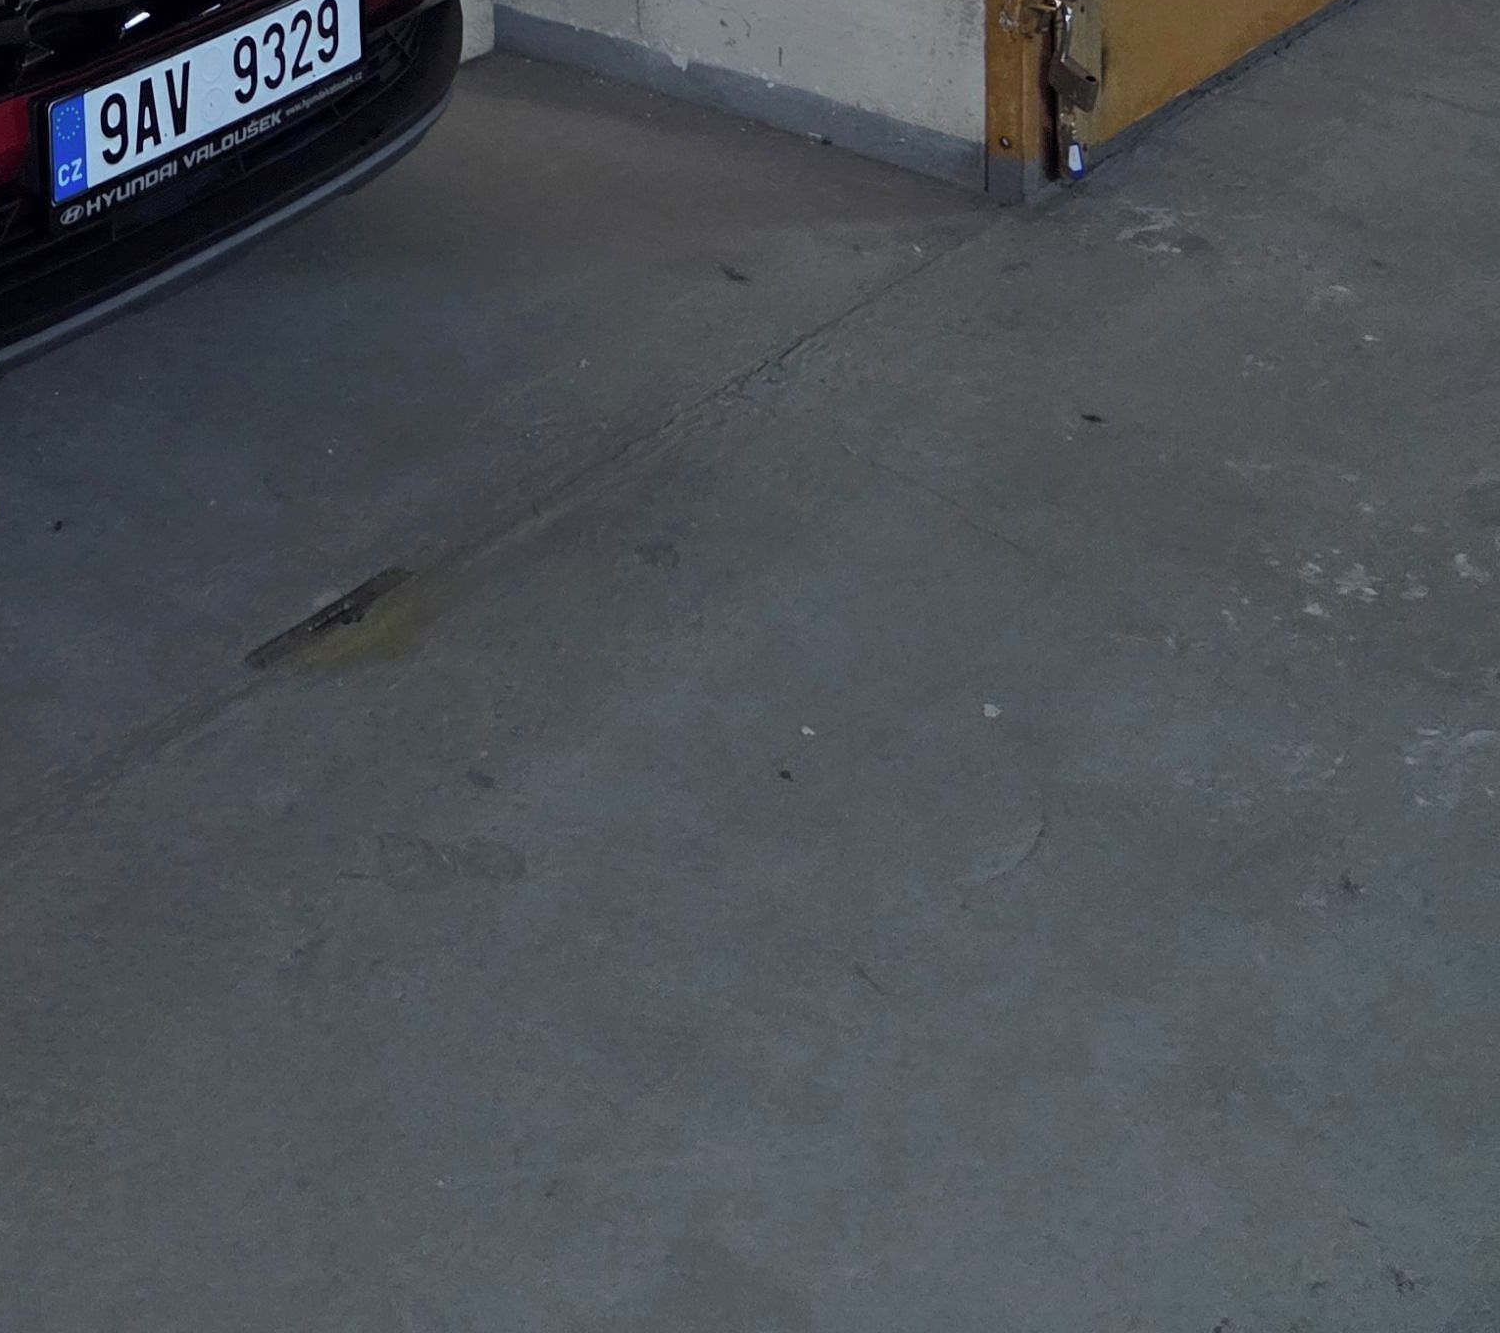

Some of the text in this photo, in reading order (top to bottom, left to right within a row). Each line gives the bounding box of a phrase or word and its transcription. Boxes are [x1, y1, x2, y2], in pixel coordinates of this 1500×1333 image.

[86, 109, 283, 217] HYUNDAI VALOUŠEK
[100, 60, 190, 165] 9AV
[58, 157, 83, 187] CZ
